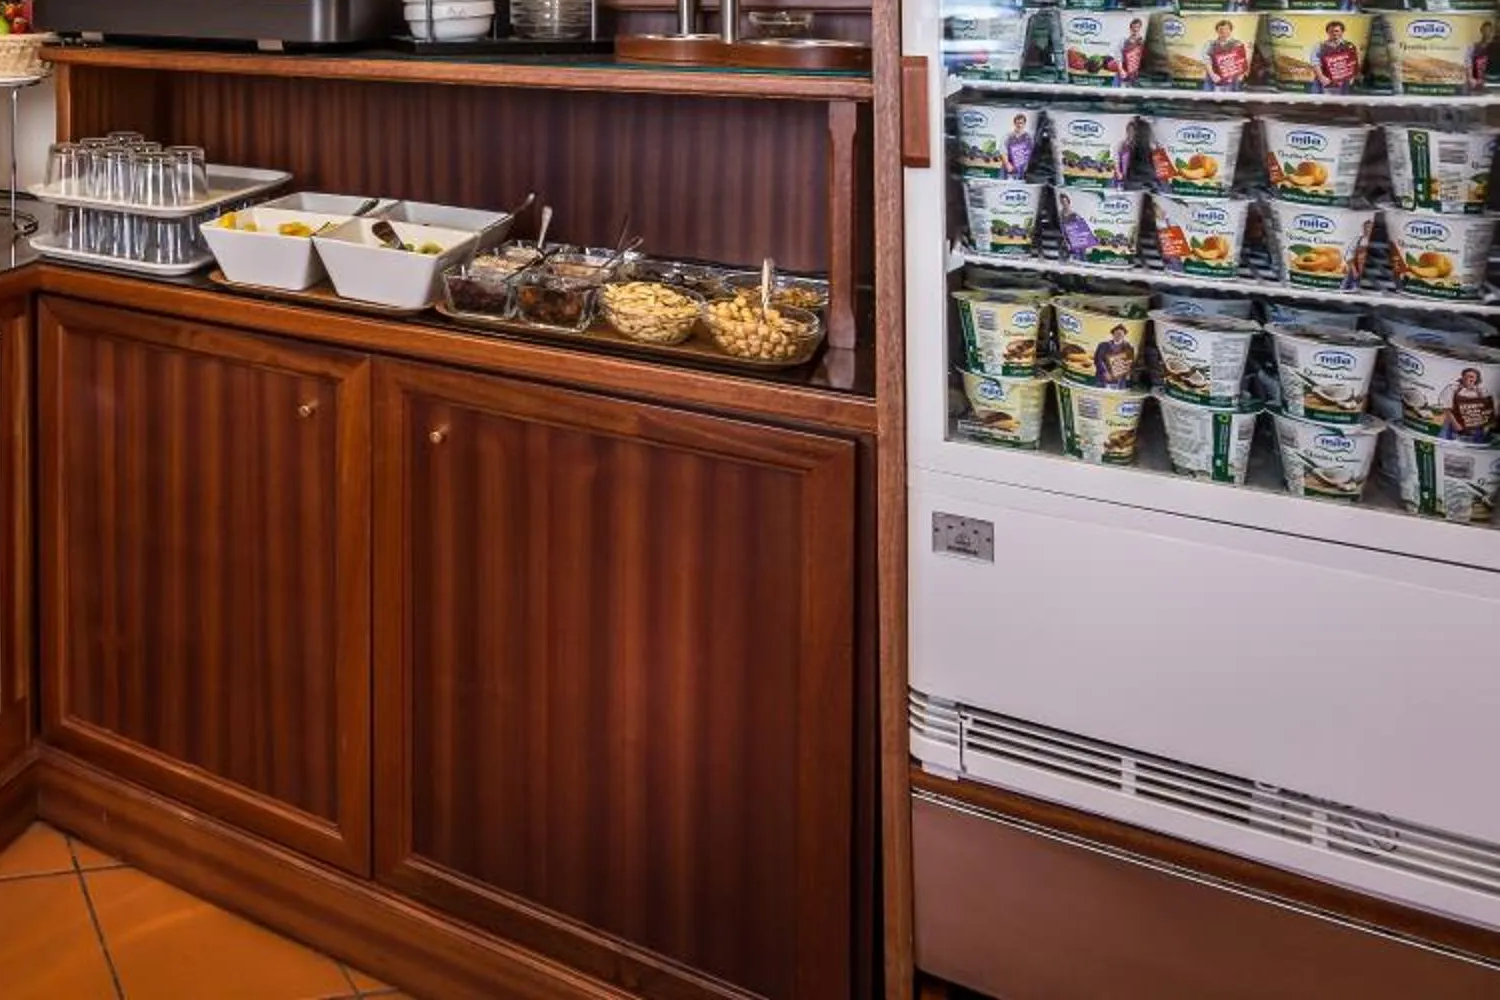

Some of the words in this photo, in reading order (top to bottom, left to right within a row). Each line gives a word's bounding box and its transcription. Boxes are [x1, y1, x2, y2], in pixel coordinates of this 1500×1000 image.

[1412, 24, 1445, 34] mila
[1291, 135, 1321, 145] mila
[1299, 219, 1329, 229] mila
[1411, 225, 1443, 236] mila
